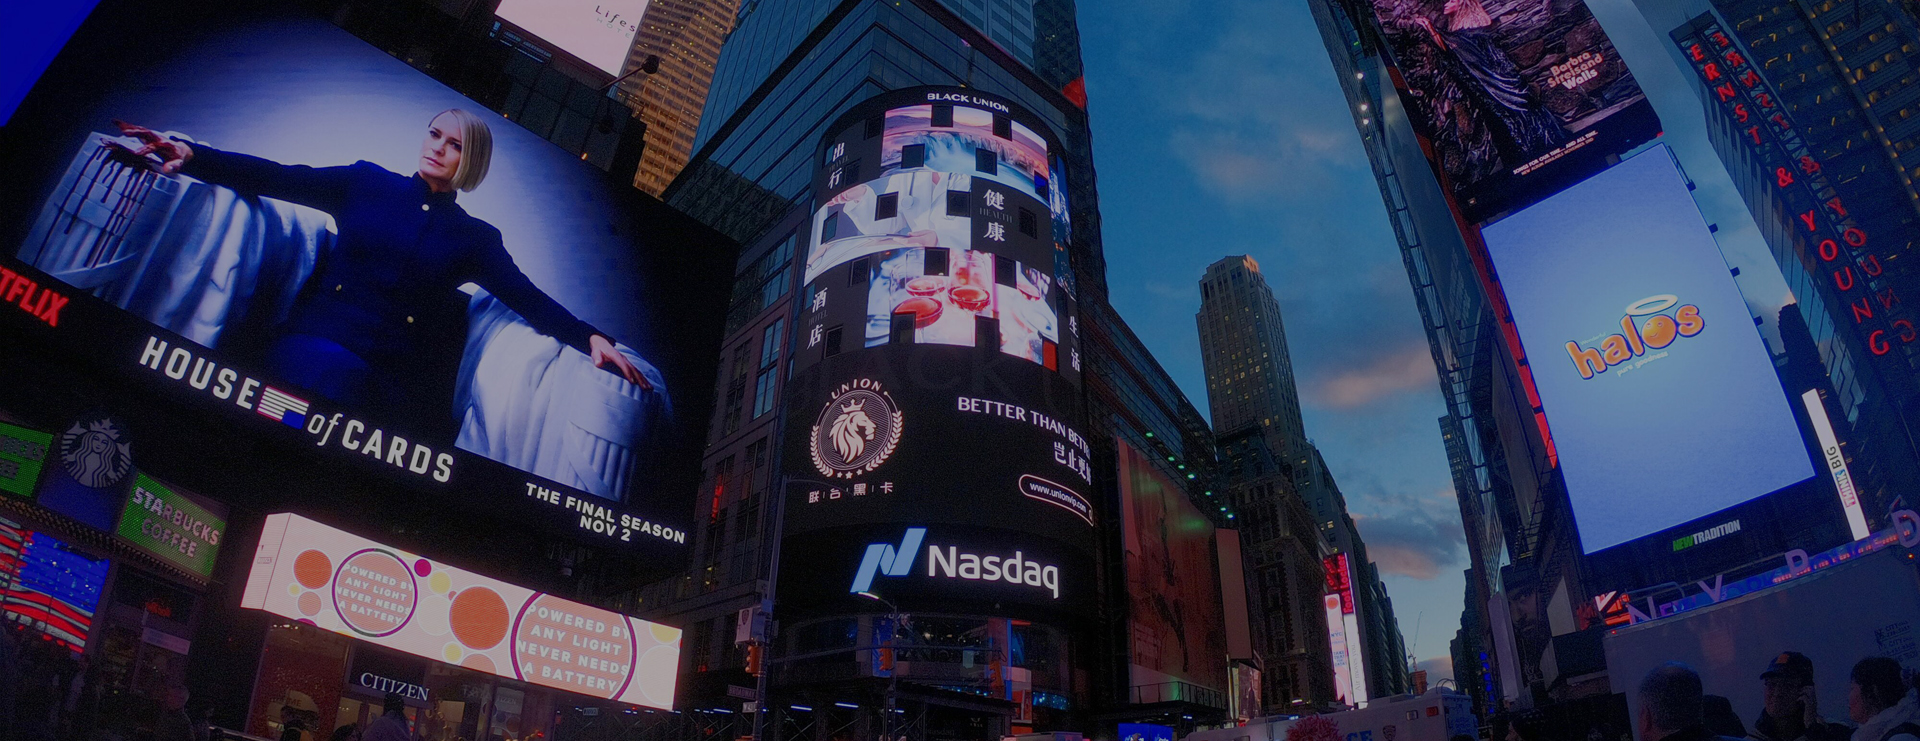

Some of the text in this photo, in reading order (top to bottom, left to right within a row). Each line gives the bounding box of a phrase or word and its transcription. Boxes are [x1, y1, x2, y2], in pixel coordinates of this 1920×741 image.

[1547, 53, 1604, 89] Streisand
[1550, 51, 1592, 76] Barbra
[1562, 68, 1599, 90] Walls
[926, 92, 1009, 114] BLACK UNION
[983, 188, 1006, 242] 健康
[1690, 43, 1890, 356] ERNST & YOUNG
[806, 286, 828, 350] 酒店
[1565, 304, 1705, 380] halos
[831, 379, 882, 400] UNION
[139, 335, 455, 484] HOUSE of CARDS
[957, 396, 1026, 422] BETTER
[1029, 410, 1066, 438] THAN
[1826, 446, 1842, 470] BIG
[132, 486, 219, 546] STARBUCKS
[525, 482, 686, 544] THE FINAL SEASON
[579, 515, 631, 542] NOV 2
[141, 518, 197, 558] COFFEE
[344, 577, 408, 601] ANY LIGHT
[927, 544, 1059, 600] Nasdaq
[339, 600, 403, 625] A BATTERY
[526, 602, 605, 633] POWERED
[530, 624, 622, 656] ANY LIGHT
[518, 639, 629, 677] NEVER NEEDS
[360, 671, 430, 701] CITIZEN
[523, 661, 617, 692] A BATTERY
